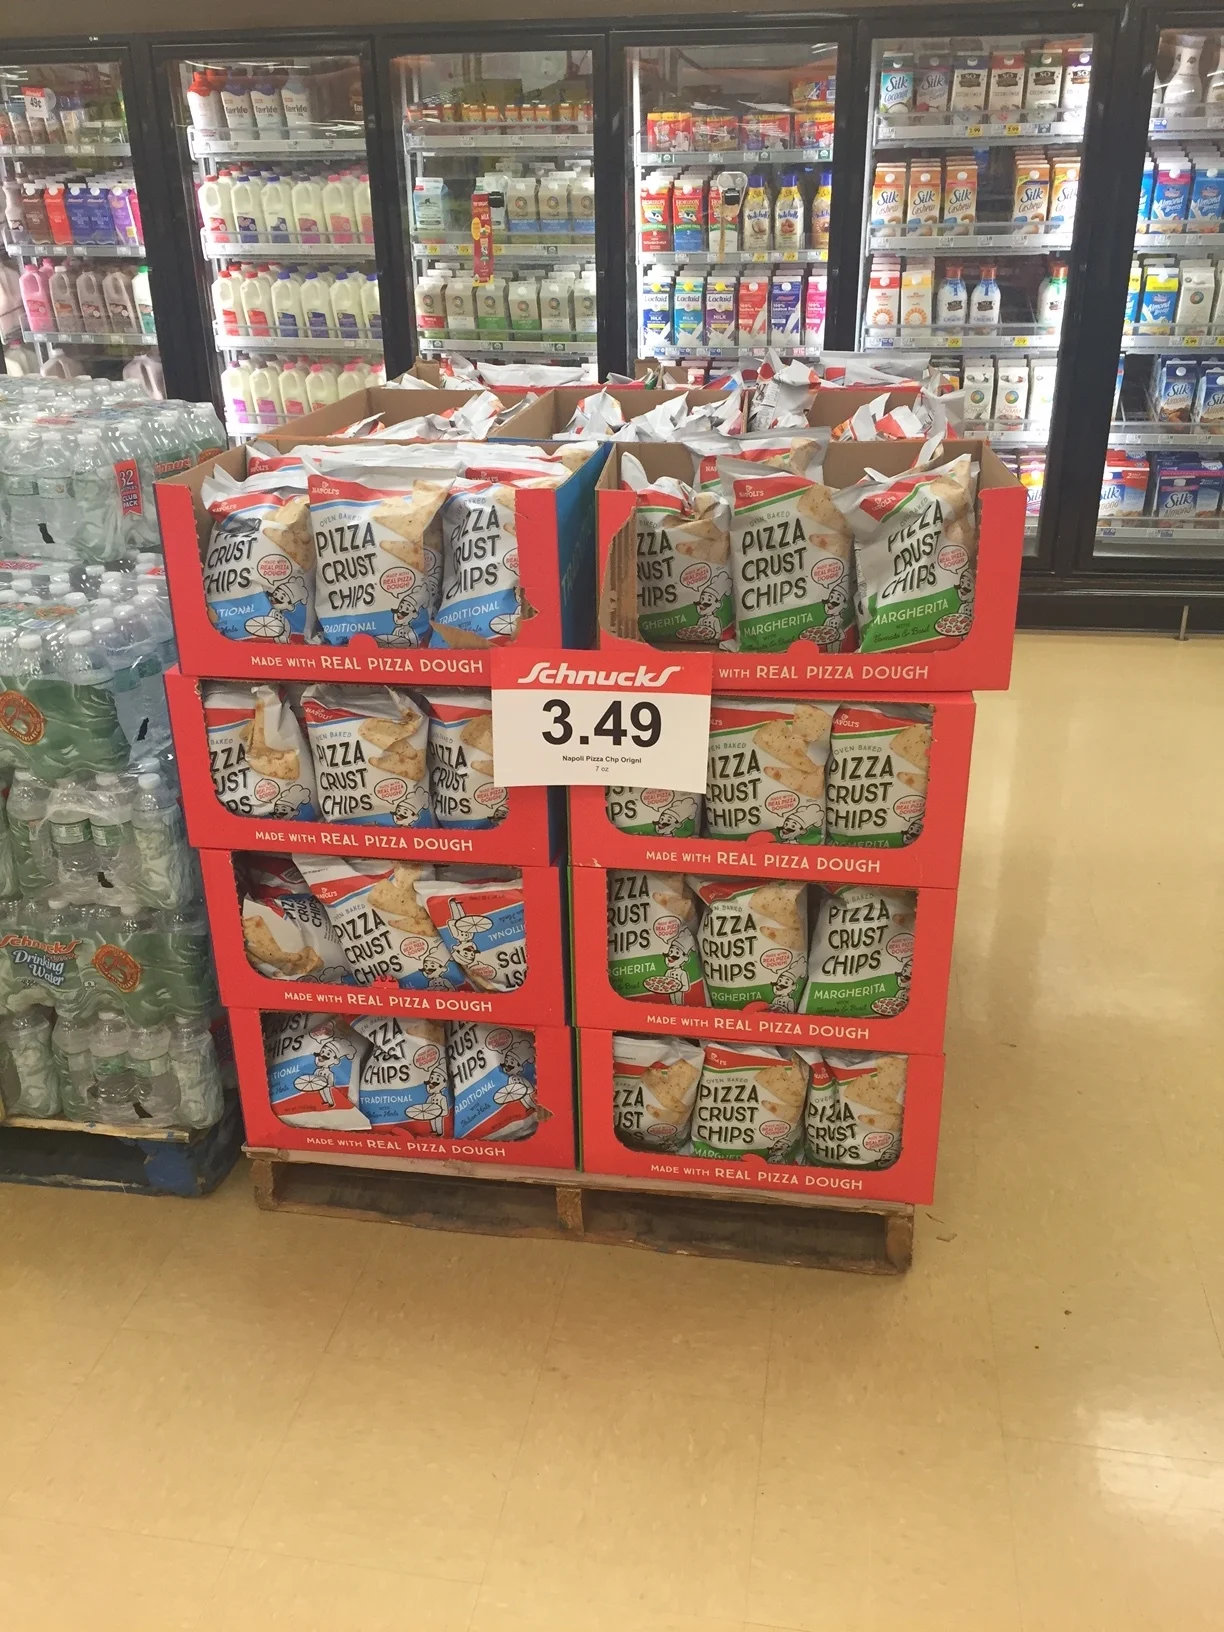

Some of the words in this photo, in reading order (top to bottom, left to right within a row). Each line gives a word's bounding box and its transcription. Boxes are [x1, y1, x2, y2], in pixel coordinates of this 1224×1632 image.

[886, 75, 908, 92] Silk
[921, 73, 944, 90] Silk
[225, 105, 248, 114] fairlife
[255, 105, 278, 114] fairlife
[285, 104, 308, 113] fairlife
[877, 191, 899, 205] Silk
[913, 190, 935, 205] Silk
[949, 188, 972, 204] Silk
[1018, 201, 1043, 213] Cashew
[1020, 188, 1043, 203] Silk
[911, 204, 936, 215] Cashew
[1167, 384, 1190, 397] Silk
[120, 469, 134, 488] 32
[123, 501, 139, 509] PACK
[1163, 505, 1193, 517] Almond
[1165, 492, 1193, 509] Silk
[450, 505, 501, 544] PIZZA
[767, 511, 791, 520] BAKED
[887, 498, 944, 553] PIZZA
[315, 521, 376, 558] PIZZA
[741, 517, 807, 555] PIZZA
[207, 537, 258, 570] CRUST
[741, 547, 807, 583] CRUST
[893, 530, 943, 577] CRUST
[321, 552, 377, 586] CRUST
[445, 563, 499, 600] CHIPS
[881, 562, 938, 600] CHIPS
[328, 583, 376, 611] CHIPS
[741, 577, 808, 611] CHIPS
[439, 601, 500, 625] TRADITIONAL
[872, 599, 949, 627] MARGHERITA
[744, 613, 814, 637] MARGHERITA
[911, 623, 931, 636] Basil
[251, 656, 283, 668] MADE
[286, 657, 316, 669] WITH
[321, 655, 362, 671] REAL
[368, 657, 415, 672] PIZZA
[420, 658, 483, 674] DOUGH
[517, 661, 682, 688] Schnucks
[719, 668, 750, 679] WITH
[756, 665, 799, 679] REAL
[806, 665, 854, 679] PIZZA
[862, 665, 929, 680] DOUGH
[541, 698, 663, 748] 3.49
[329, 731, 352, 739] BAKED
[315, 740, 366, 768] PIZZA
[562, 755, 585, 764] Napoli
[605, 756, 620, 764] Chp
[620, 756, 642, 765] Orignl
[834, 746, 855, 756] OVEN
[858, 744, 883, 753] BAKED
[320, 767, 368, 791] CRUST
[828, 754, 895, 781] PIZZA
[431, 766, 468, 793] CRUST
[826, 781, 893, 805] CRUST
[322, 794, 374, 816] CHIPS
[255, 831, 285, 842] MADE
[288, 833, 316, 843] WITH
[321, 832, 359, 846] REAL
[365, 835, 408, 849] PIZZA
[413, 837, 473, 852] DOUGH
[646, 851, 678, 862] MADE
[682, 853, 711, 863] WITH
[717, 851, 757, 867] REAL
[764, 854, 810, 869] PIZZA
[816, 857, 880, 873] DOUGH
[612, 874, 650, 901] IZZA
[345, 903, 366, 915] BAKED
[607, 901, 651, 928] RUST
[828, 898, 891, 925] PIZZA
[332, 909, 387, 944] PIZZA
[703, 912, 758, 938] PIZZA
[344, 930, 393, 965] CRUST
[608, 929, 651, 954] HIPS
[701, 935, 759, 960] CRUST
[827, 924, 889, 951] CRUST
[12, 949, 65, 975] Drinking
[353, 953, 403, 986] CHIPS
[702, 961, 757, 983] CHIPS
[820, 949, 883, 977] CHIPS
[28, 964, 65, 987] Water
[284, 991, 313, 1002] MADE
[316, 993, 343, 1004] WITH
[347, 993, 384, 1007] REAL
[389, 995, 431, 1009] PIZZA
[436, 998, 492, 1013] DOUGH
[813, 983, 886, 1000] MARGHERITA
[646, 1014, 677, 1026] MADE
[681, 1018, 709, 1028] WITH
[714, 1017, 752, 1031] REAL
[759, 1021, 803, 1035] PIZZA
[809, 1024, 870, 1040] DOUGH
[363, 1063, 411, 1084] CHIPS
[360, 1094, 413, 1105] TRADITIONAL
[455, 1080, 496, 1115] RADITIONAL
[699, 1084, 760, 1104] PIZZA
[698, 1106, 759, 1123] CRUST
[697, 1125, 756, 1144] CHIPS
[806, 1123, 858, 1142] CRUST
[306, 1137, 335, 1147] MADE
[337, 1139, 363, 1148] WITH
[366, 1139, 402, 1151] REAL
[407, 1141, 447, 1154] PIZZA
[452, 1144, 506, 1157] DOUGH
[651, 1164, 680, 1175] MADE
[683, 1167, 710, 1177] WITH
[715, 1167, 752, 1181] REAL
[757, 1171, 799, 1185] PIZZA
[805, 1175, 863, 1191] DOUGH
